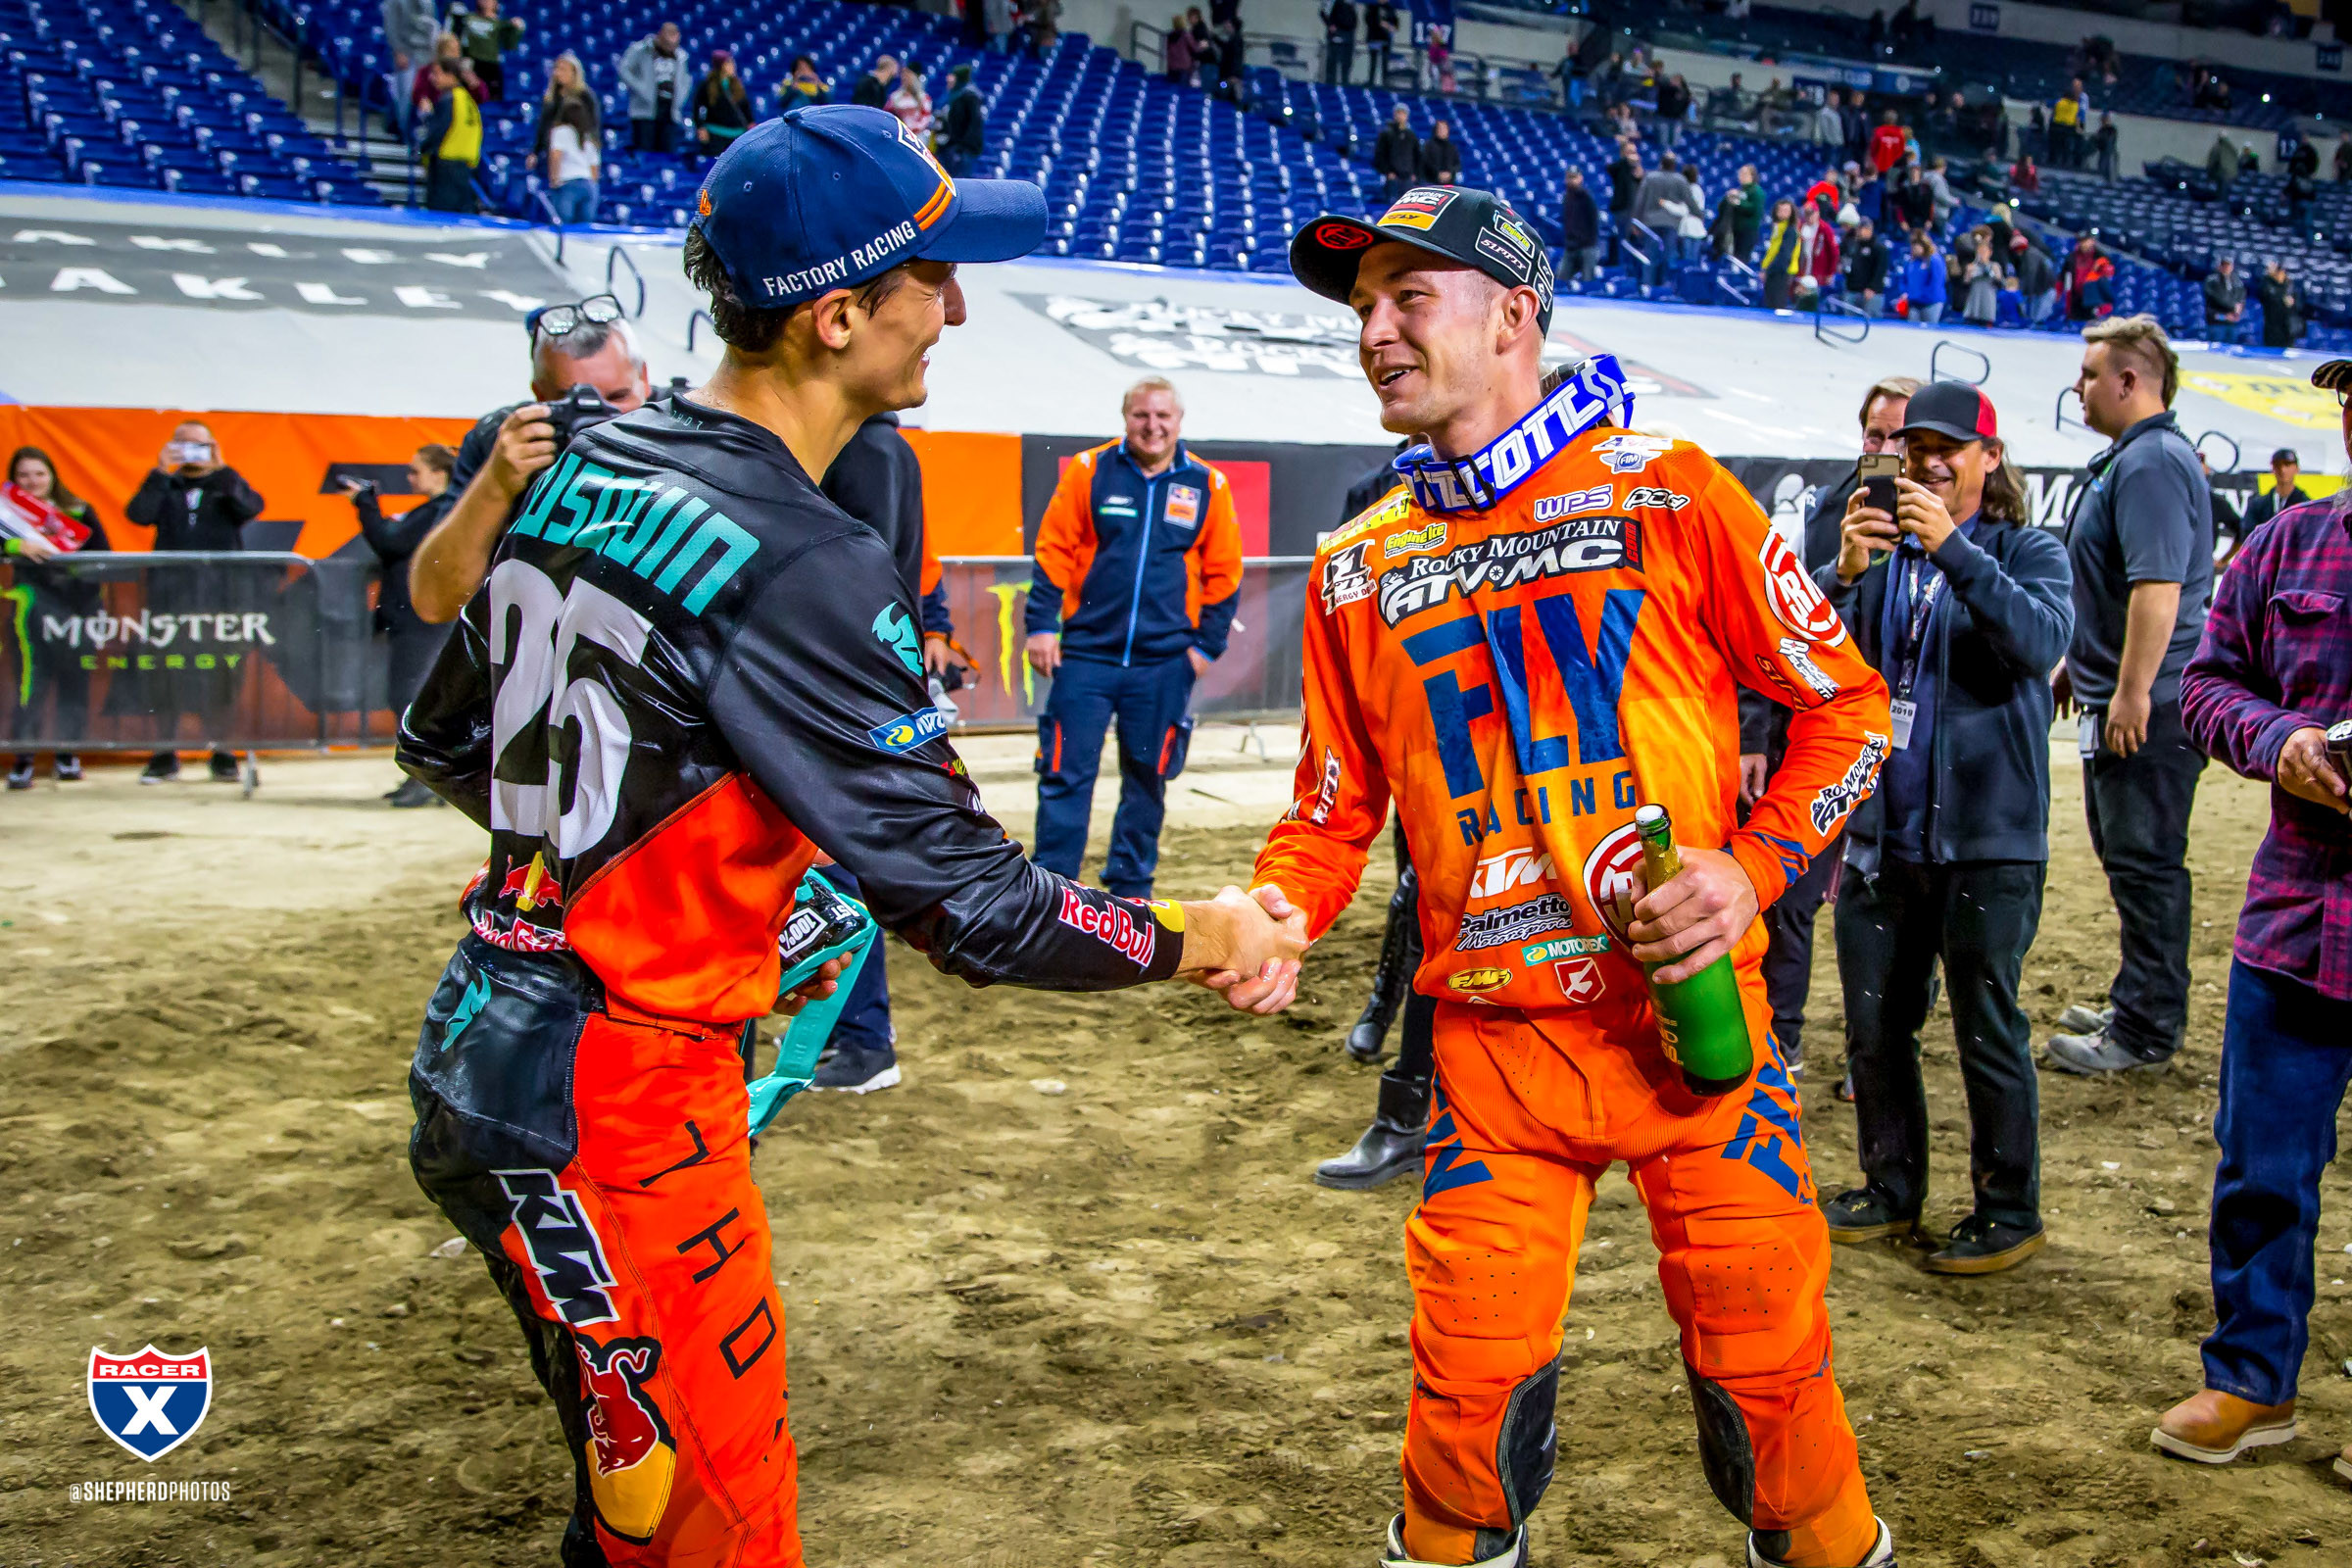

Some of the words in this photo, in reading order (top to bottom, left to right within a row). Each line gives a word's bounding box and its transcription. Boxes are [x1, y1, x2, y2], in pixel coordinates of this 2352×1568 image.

[762, 256, 849, 297] FACTORY
[850, 220, 917, 270] RACING
[1480, 238, 1528, 271] 51FIFTY
[1620, 455, 1640, 466] FIM
[1536, 485, 1612, 521] WPS
[508, 450, 761, 618] USQUIN
[1409, 544, 1485, 580] ROCKY
[1491, 519, 1621, 557] MOUNTAIN
[1334, 590, 1359, 605] NERGY
[79, 653, 242, 670] ENERGY
[489, 558, 655, 859] 25
[1399, 588, 1647, 800] FLY
[1455, 769, 1637, 847] RACING
[1469, 847, 1559, 899] KTM
[778, 914, 817, 951] 100%
[1456, 919, 1574, 951] Motorsports
[1458, 896, 1571, 936] Palmetto
[1546, 936, 1608, 958] MOTOREX
[1447, 969, 1510, 990] FMF
[490, 1168, 620, 1327] KTM
